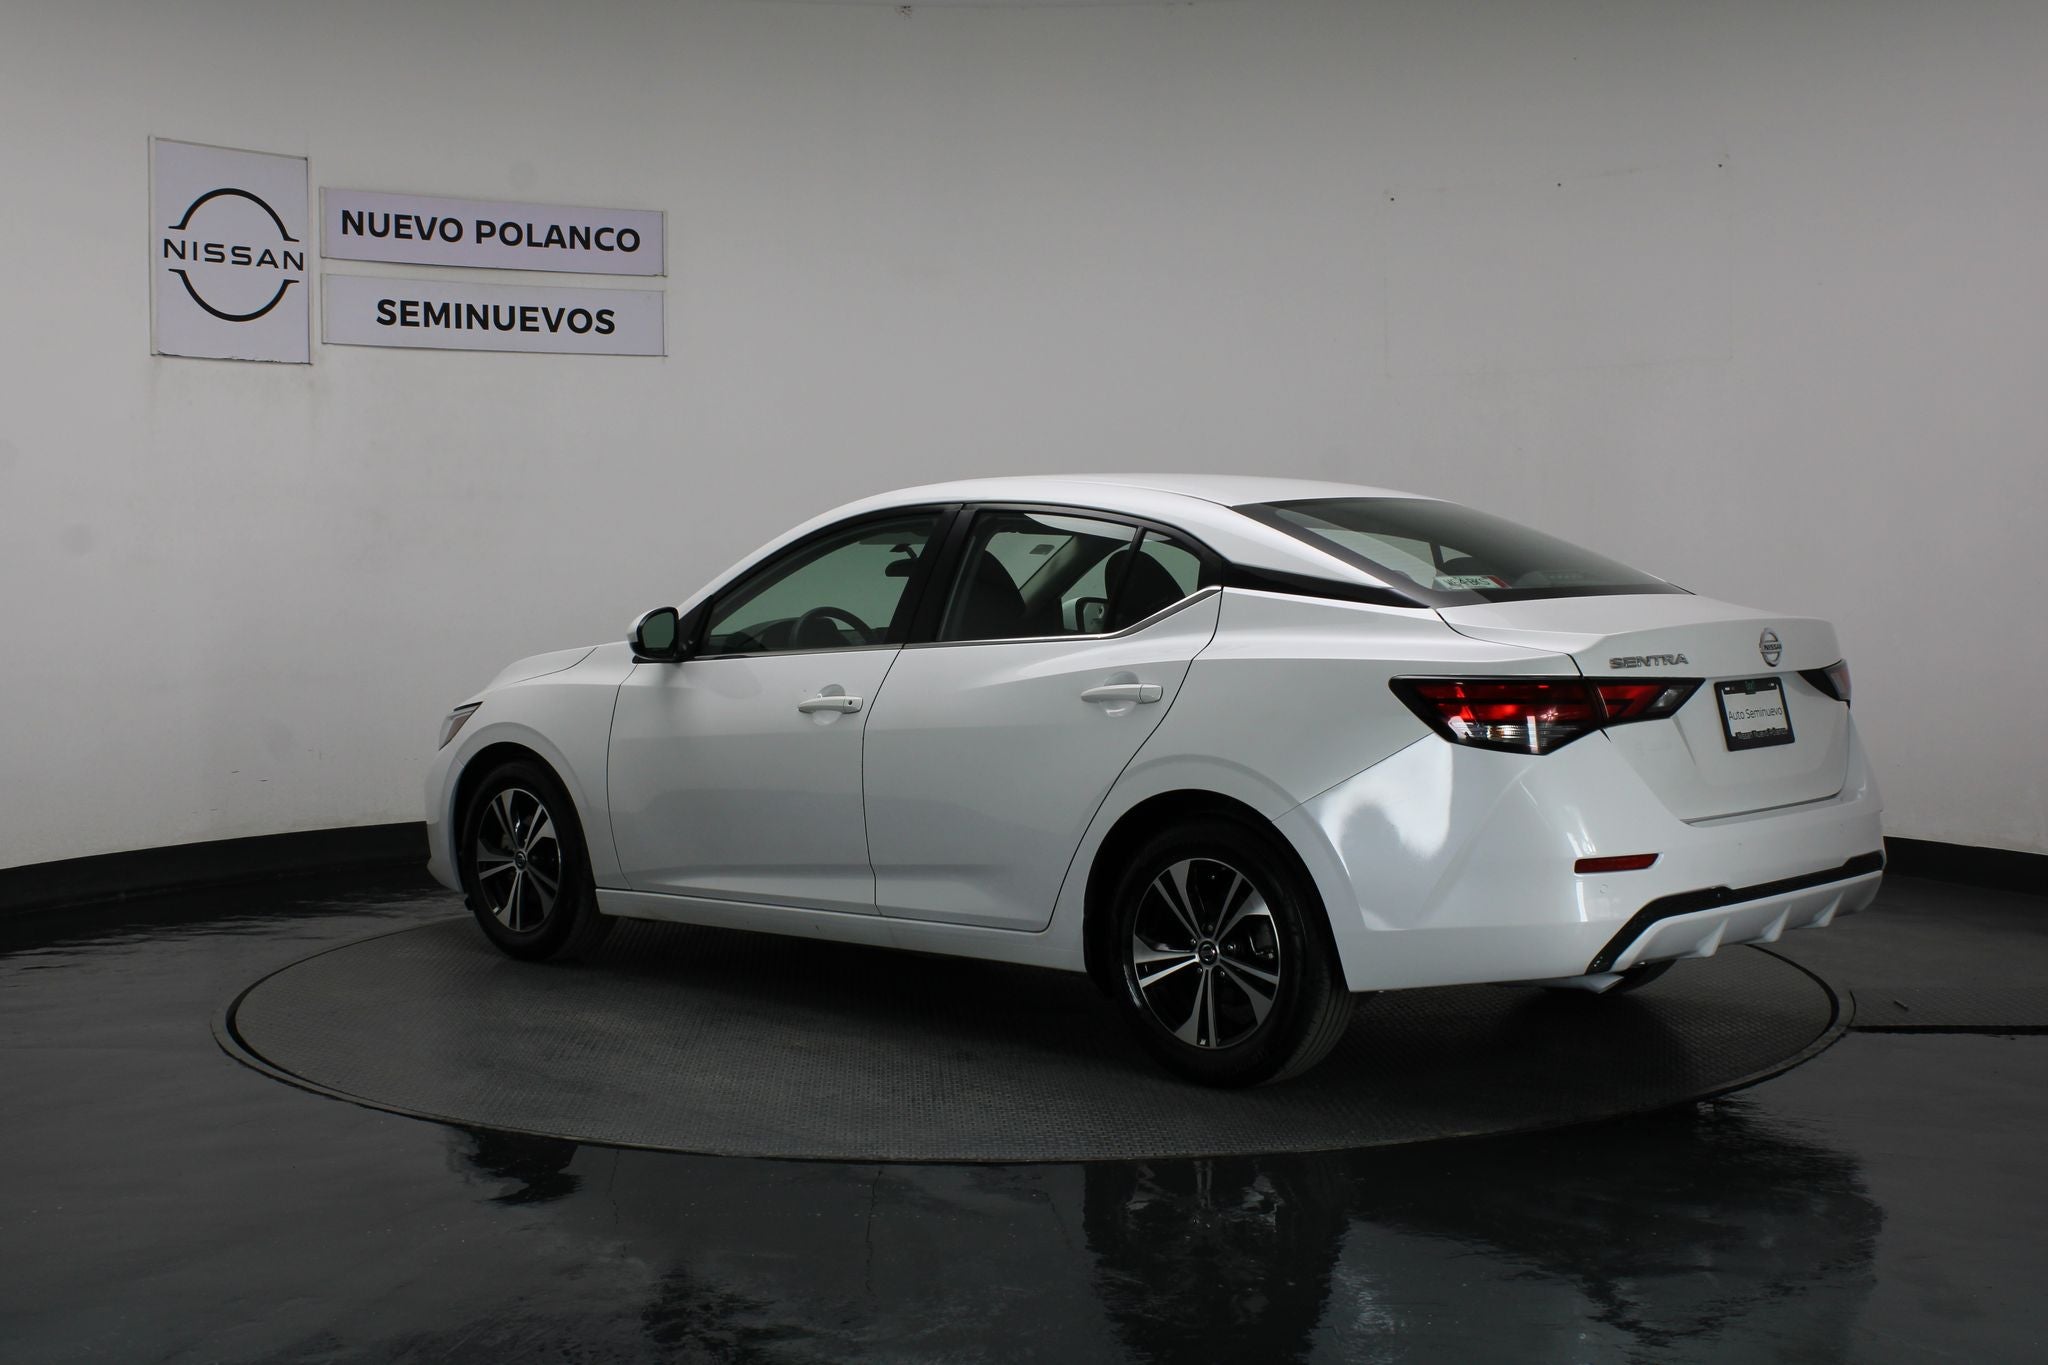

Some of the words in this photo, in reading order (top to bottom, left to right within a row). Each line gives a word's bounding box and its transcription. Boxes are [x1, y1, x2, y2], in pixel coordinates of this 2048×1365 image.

[341, 209, 464, 243] NUEVO
[476, 220, 641, 253] POLANCO
[164, 238, 304, 271] NISSAN
[376, 299, 616, 335] SEMINUEVOS
[1610, 653, 1689, 669] SENTRA
[1729, 711, 1745, 721] Auto
[1745, 707, 1783, 719] Seminuevo
